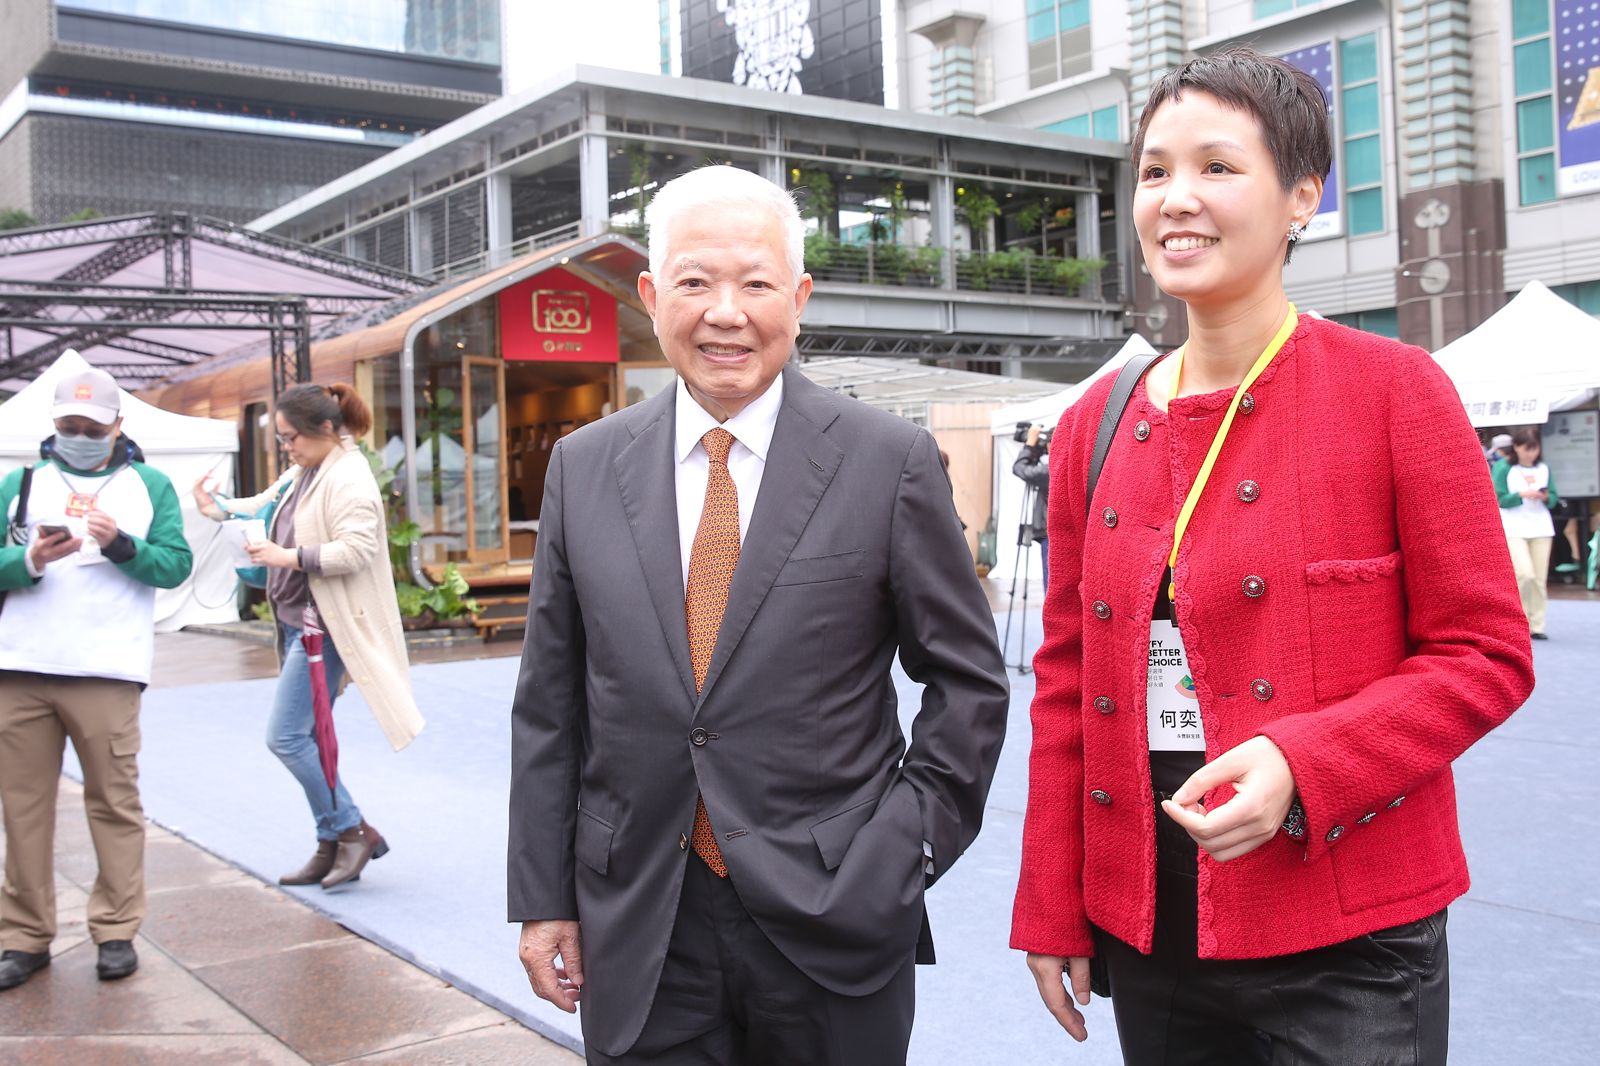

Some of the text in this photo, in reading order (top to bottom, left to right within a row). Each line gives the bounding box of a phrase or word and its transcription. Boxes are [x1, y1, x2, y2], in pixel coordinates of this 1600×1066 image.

[1148, 649, 1181, 657] BETTER
[1148, 658, 1183, 666] CHOICE
[1159, 709, 1203, 729] 何奕
